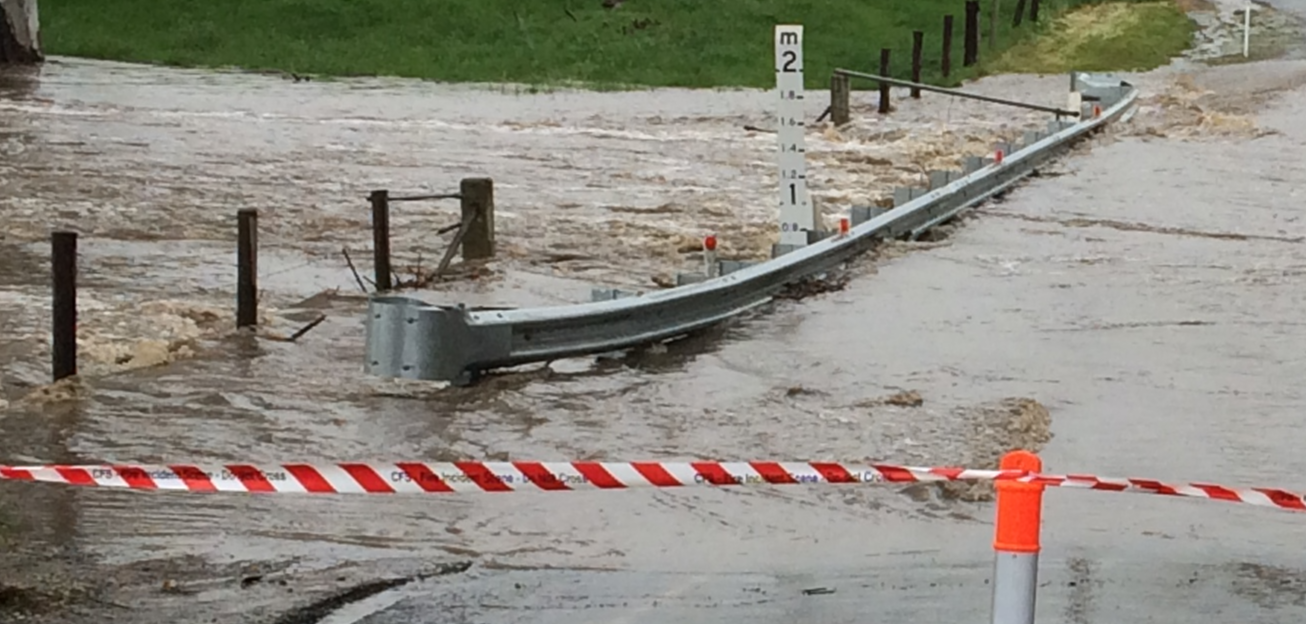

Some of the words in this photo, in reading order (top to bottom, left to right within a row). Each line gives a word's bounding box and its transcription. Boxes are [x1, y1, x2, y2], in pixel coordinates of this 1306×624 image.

[780, 31, 798, 45] m
[782, 50, 797, 73] 2
[789, 183, 797, 205] 1
